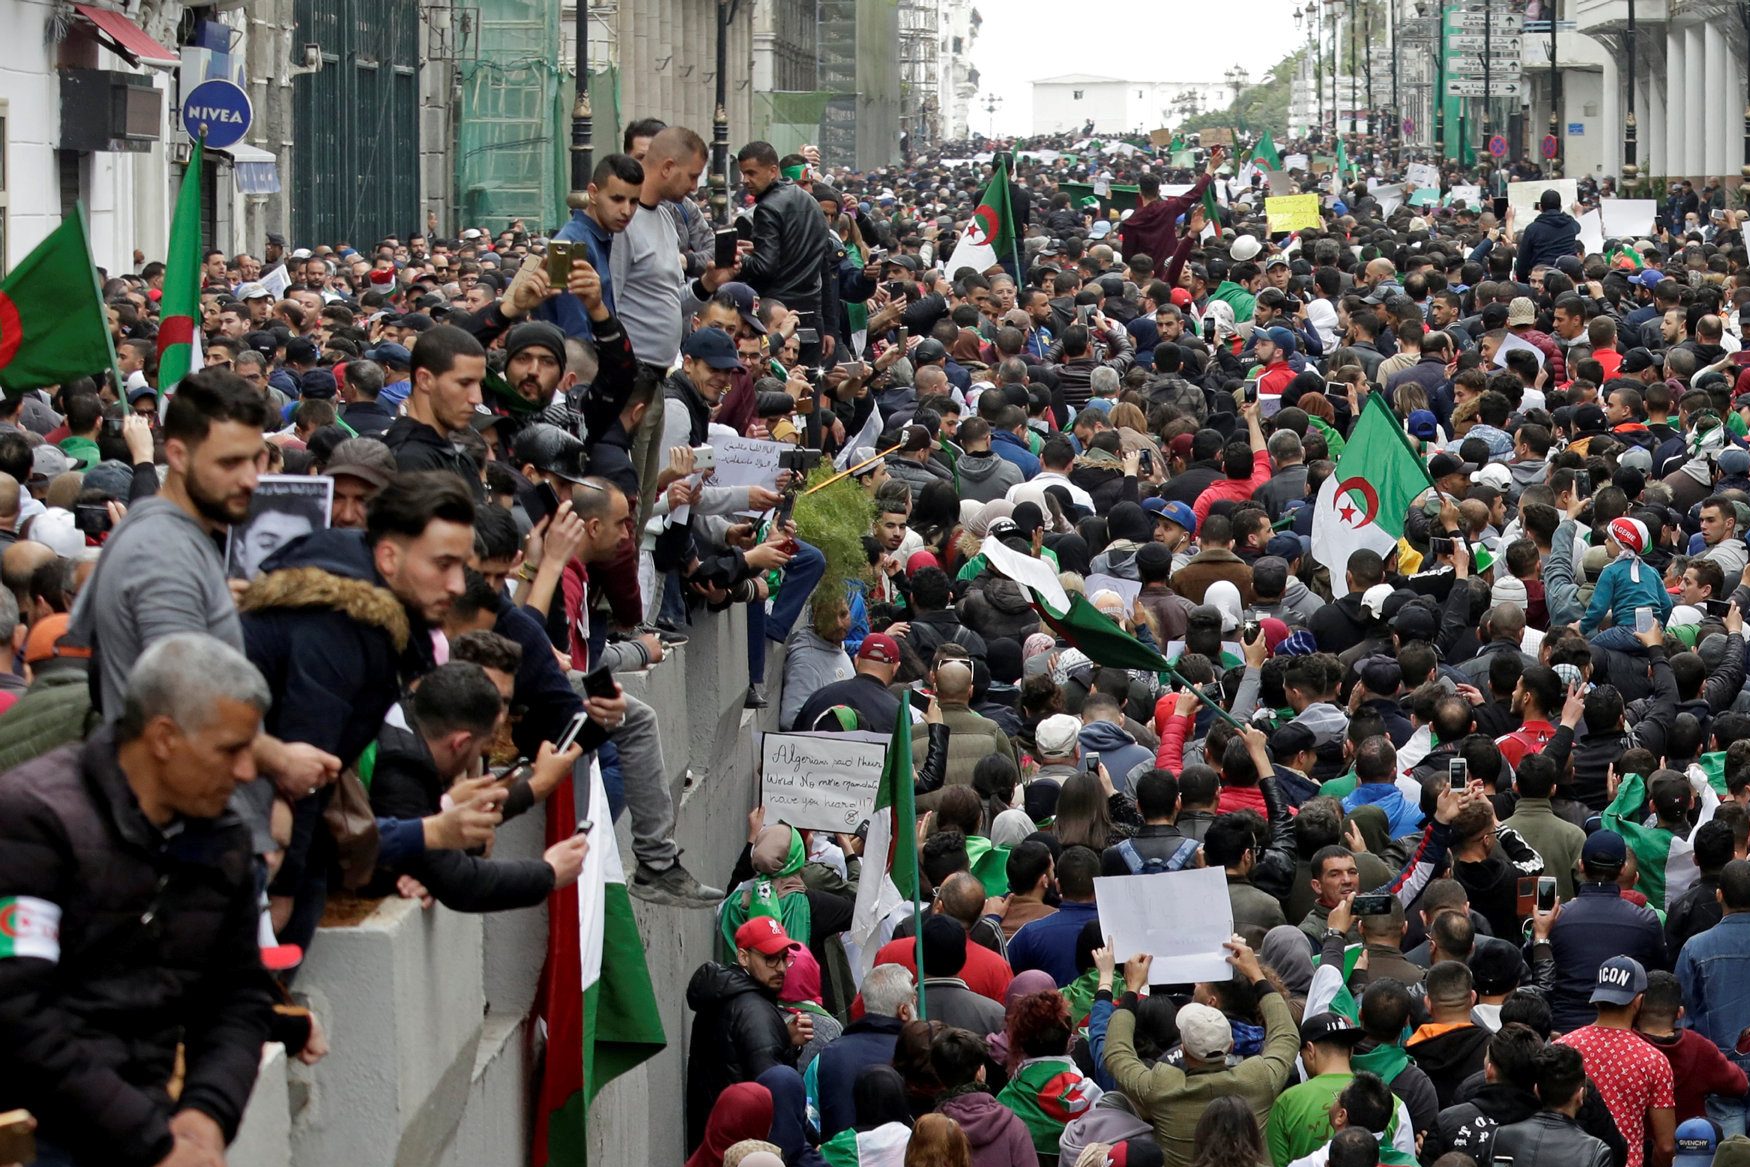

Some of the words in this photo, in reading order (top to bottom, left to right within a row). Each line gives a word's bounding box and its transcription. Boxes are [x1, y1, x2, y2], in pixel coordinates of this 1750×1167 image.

[187, 105, 243, 124] NIVEA
[1599, 967, 1630, 987] ICON
[1679, 1139, 1708, 1147] GIVENCHY
